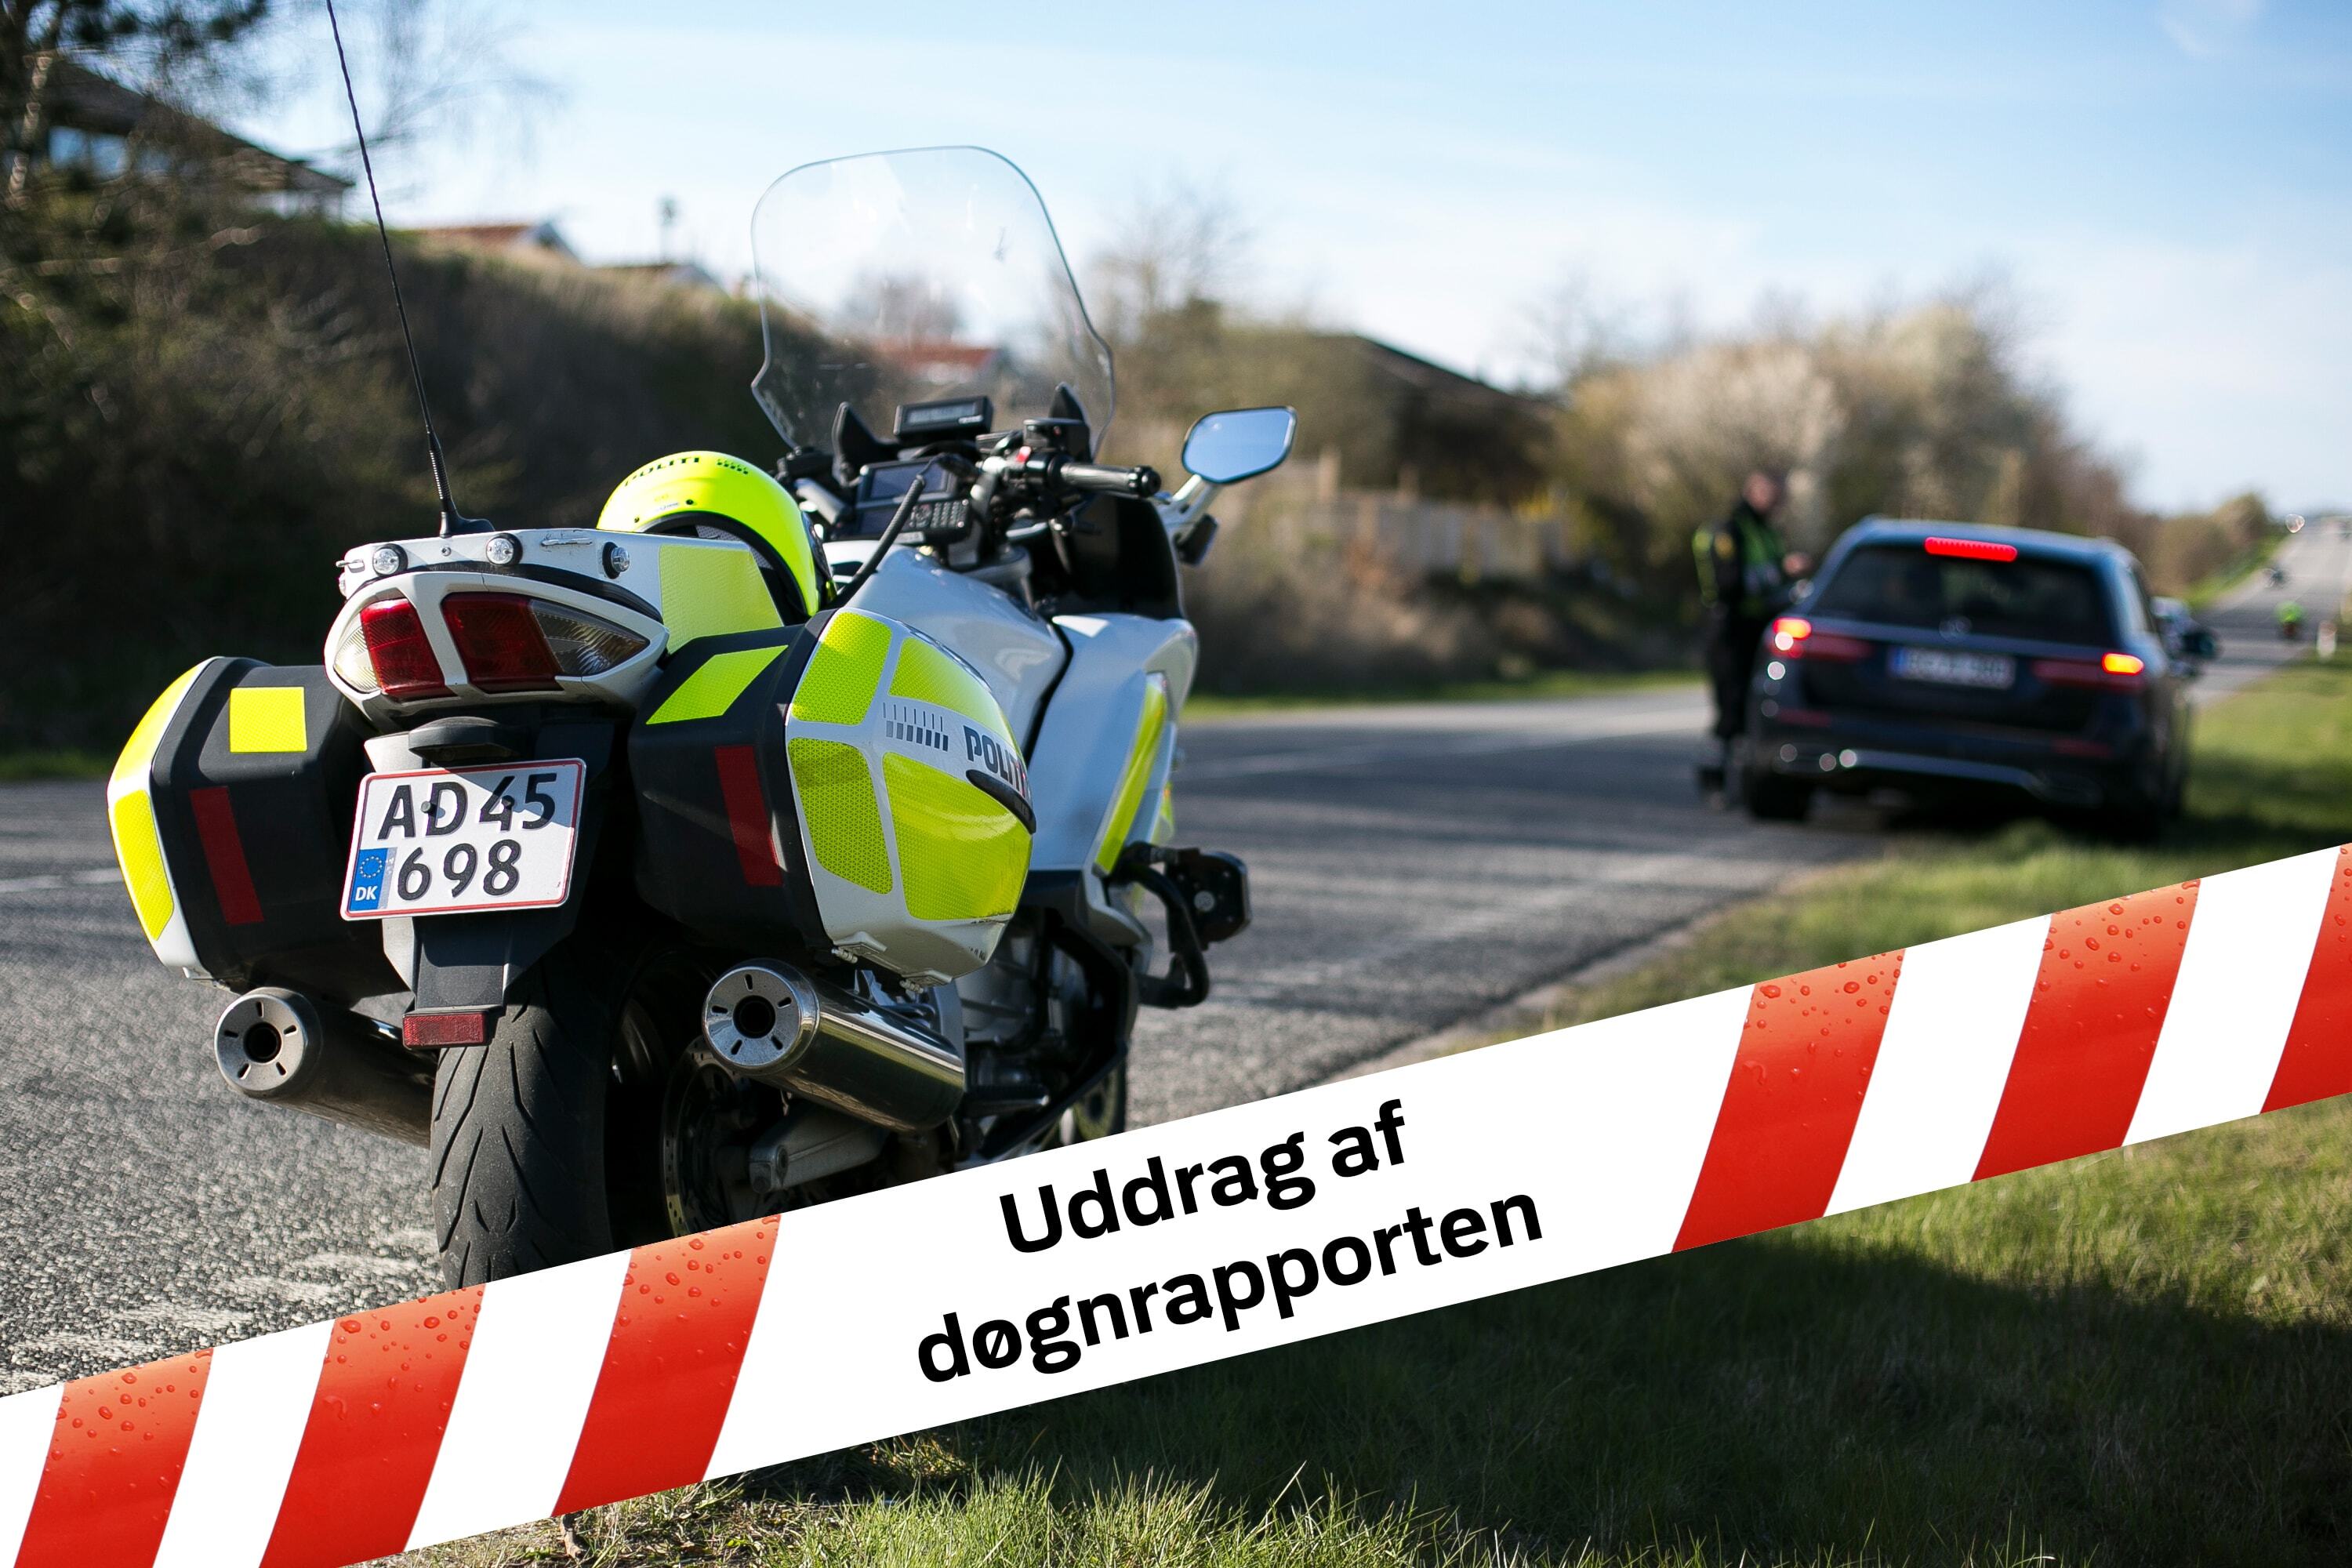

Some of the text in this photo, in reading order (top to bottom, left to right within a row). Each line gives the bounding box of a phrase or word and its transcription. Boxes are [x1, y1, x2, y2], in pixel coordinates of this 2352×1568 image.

[624, 456, 700, 487] POLITI
[377, 772, 557, 840] AD 45
[355, 886, 378, 901] DK
[397, 840, 521, 901] 698
